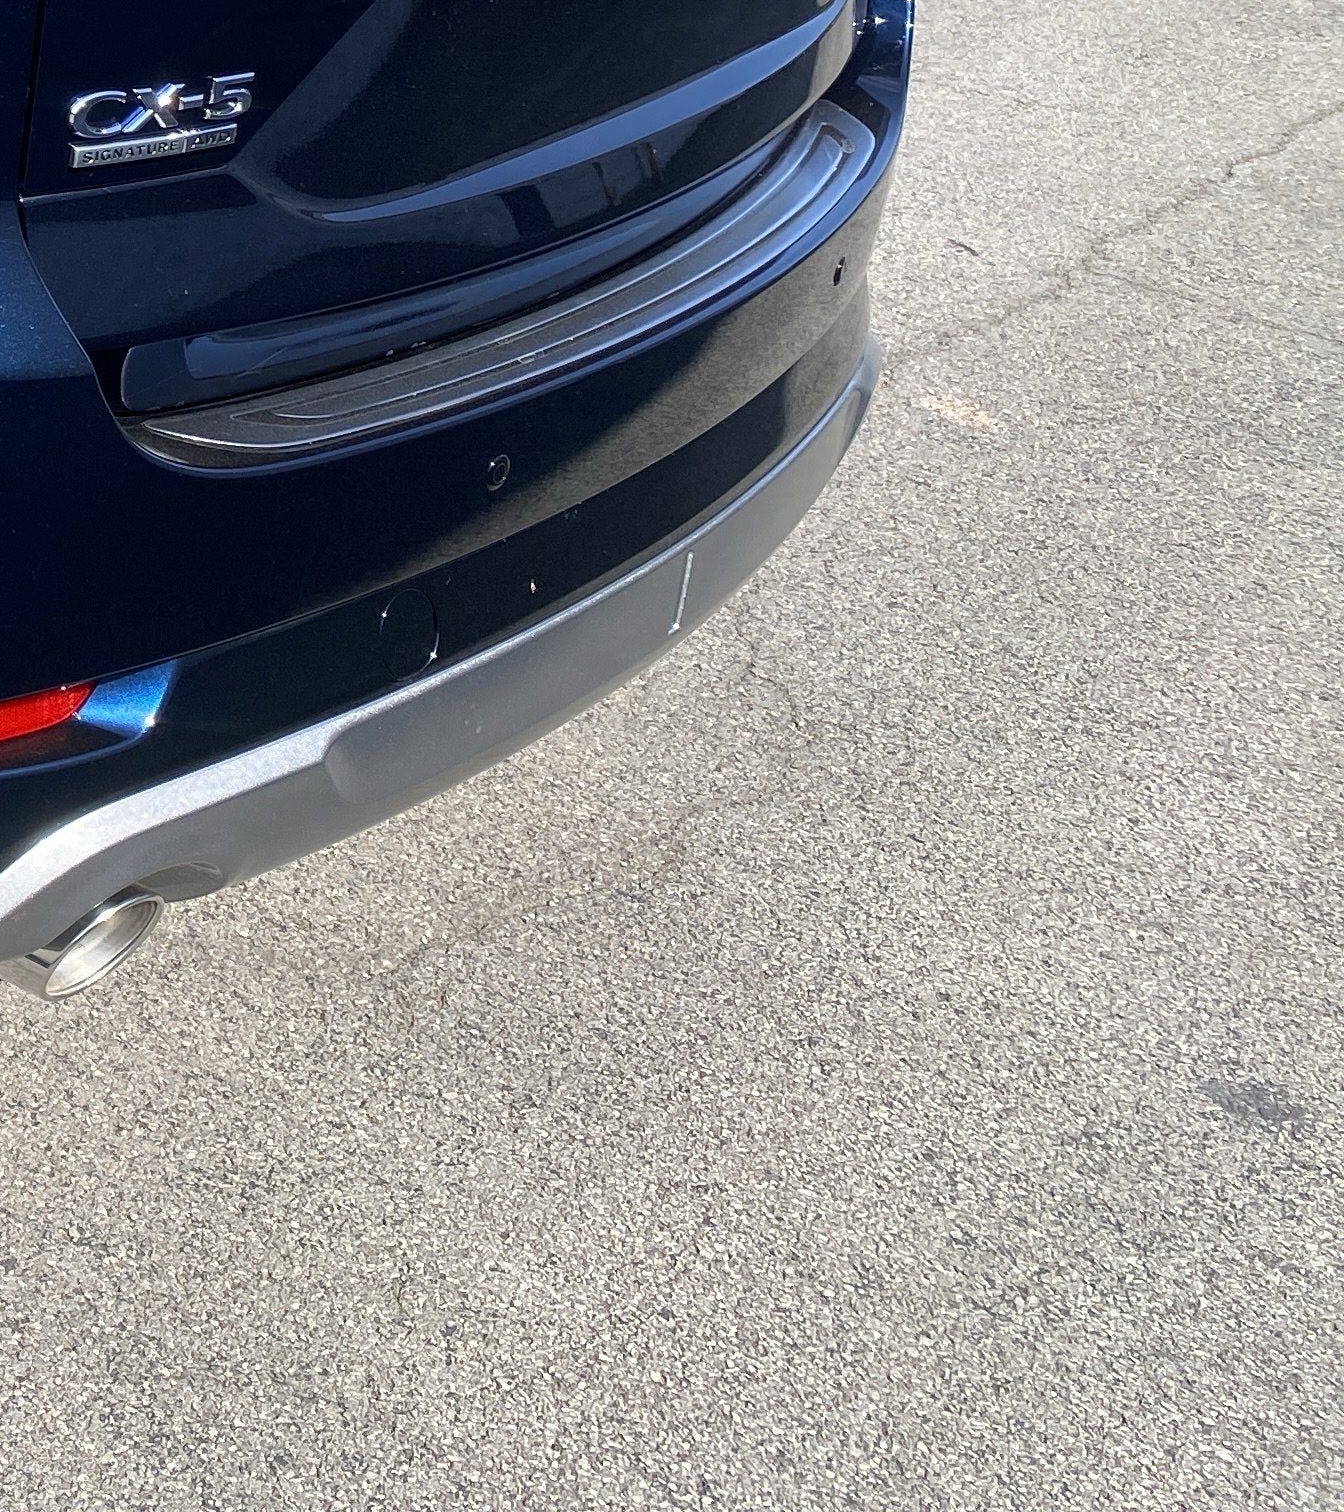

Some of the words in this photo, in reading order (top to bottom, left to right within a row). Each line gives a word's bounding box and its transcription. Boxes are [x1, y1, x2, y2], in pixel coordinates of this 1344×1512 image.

[68, 71, 256, 139] CX-5
[82, 140, 179, 164] SIGNATURE
[191, 131, 232, 148] AWD
